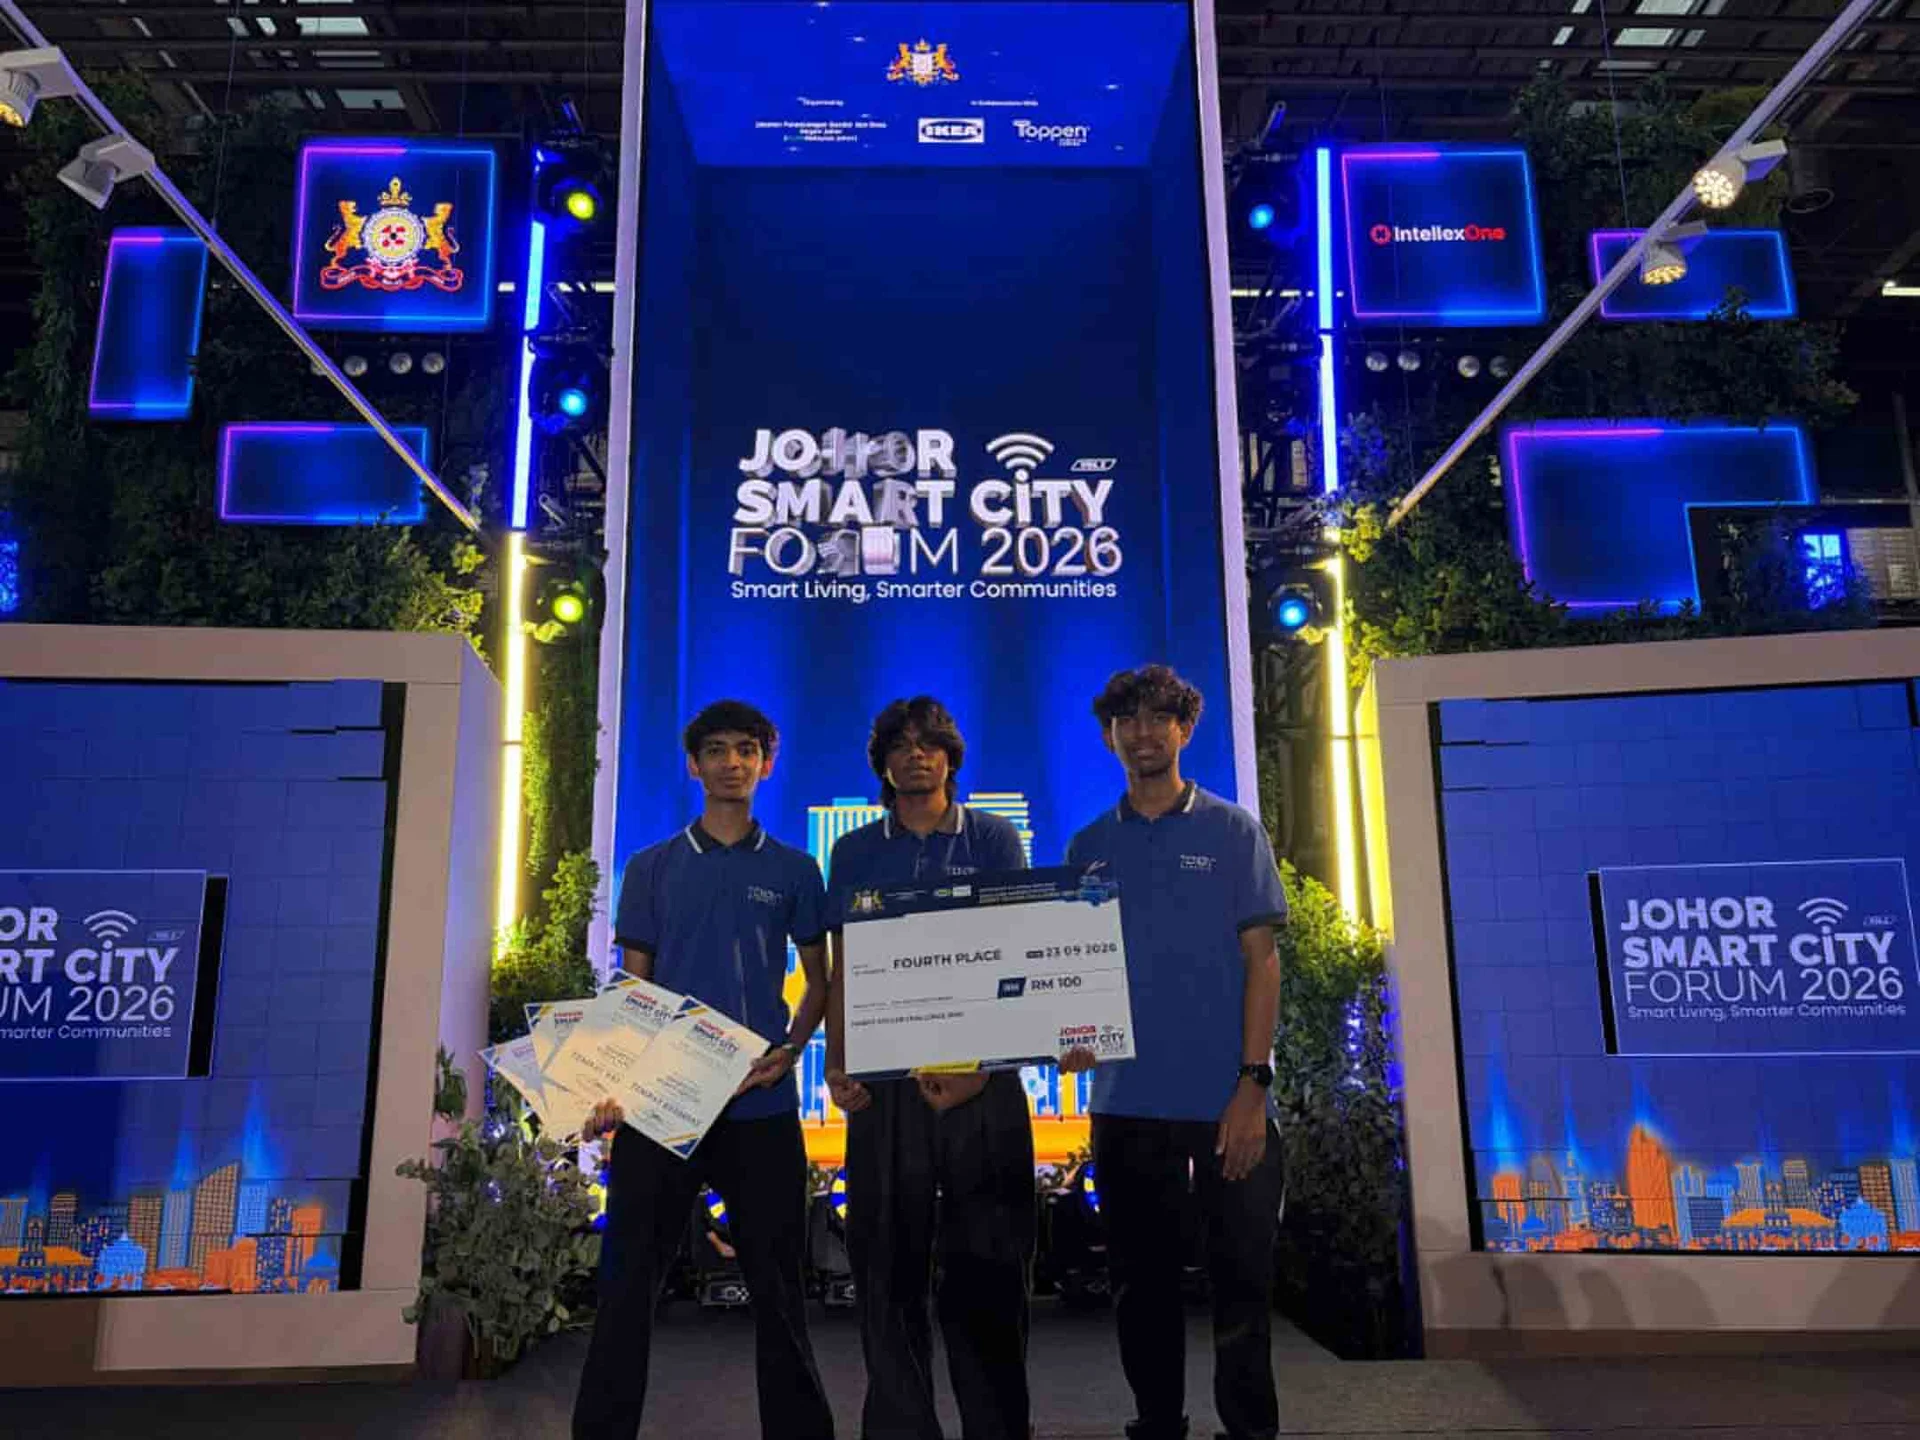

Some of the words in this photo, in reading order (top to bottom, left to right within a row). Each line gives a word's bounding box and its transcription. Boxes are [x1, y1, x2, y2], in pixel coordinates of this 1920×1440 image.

[925, 125, 977, 136] IKEA
[1012, 119, 1087, 141] Toppen
[1394, 224, 1506, 242] IntellexOne
[734, 479, 956, 528] SMART
[980, 526, 1122, 576] 2026
[731, 581, 798, 598] Smart
[804, 580, 870, 603] Living,
[877, 581, 965, 598] Smarter
[969, 579, 1117, 598] Communities
[1620, 897, 1777, 931] JOHOR
[893, 954, 952, 969] FOURTH
[955, 950, 1002, 965] PLACE
[1622, 934, 1778, 969] SMART
[1031, 979, 1054, 991] RM
[1058, 976, 1082, 988] 100
[1623, 969, 1787, 1003] FORUM
[1800, 967, 1904, 1001] 2026
[65, 985, 175, 1022] 2026
[1627, 1006, 1676, 1018] Smart
[1678, 1005, 1727, 1022] Living,
[1730, 1004, 1794, 1018] Smarter
[1798, 1003, 1907, 1017] Communities
[57, 1025, 172, 1039] Communities
